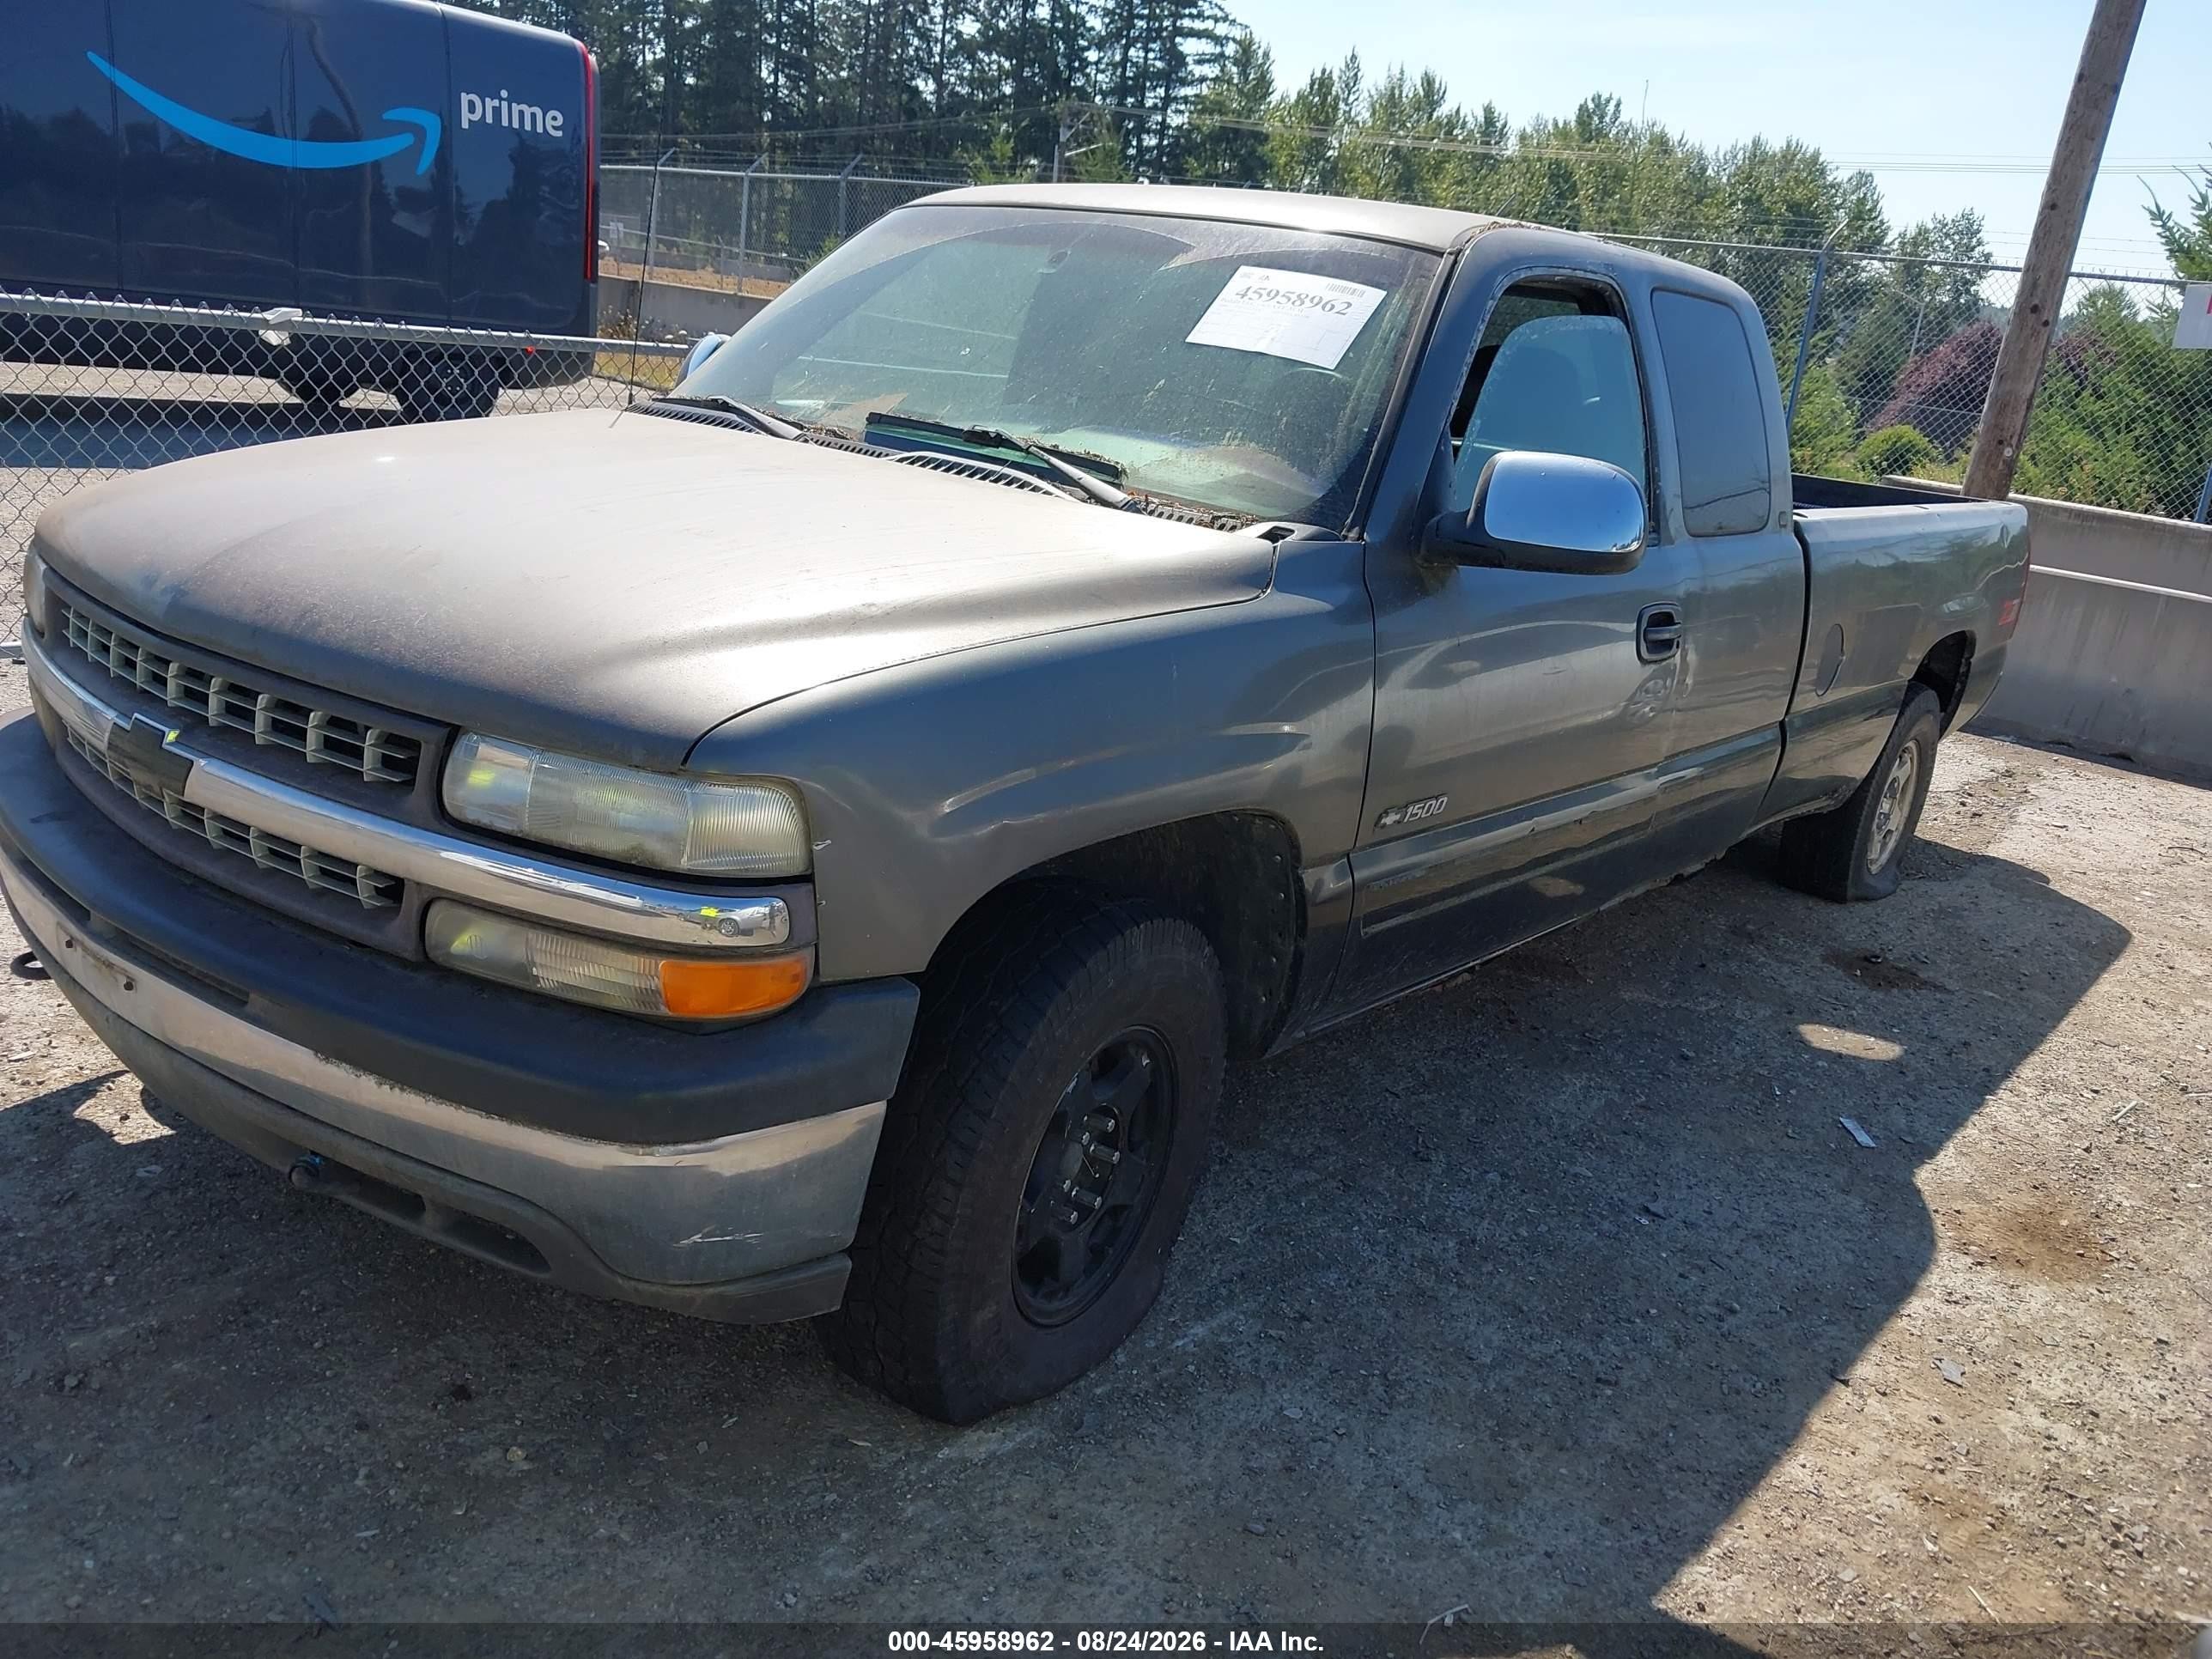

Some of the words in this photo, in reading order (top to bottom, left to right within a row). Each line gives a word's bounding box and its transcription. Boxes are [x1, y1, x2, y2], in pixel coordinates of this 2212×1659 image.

[460, 88, 564, 137] prime
[1235, 285, 1353, 316] 45958962
[1402, 796, 1449, 823] 1500
